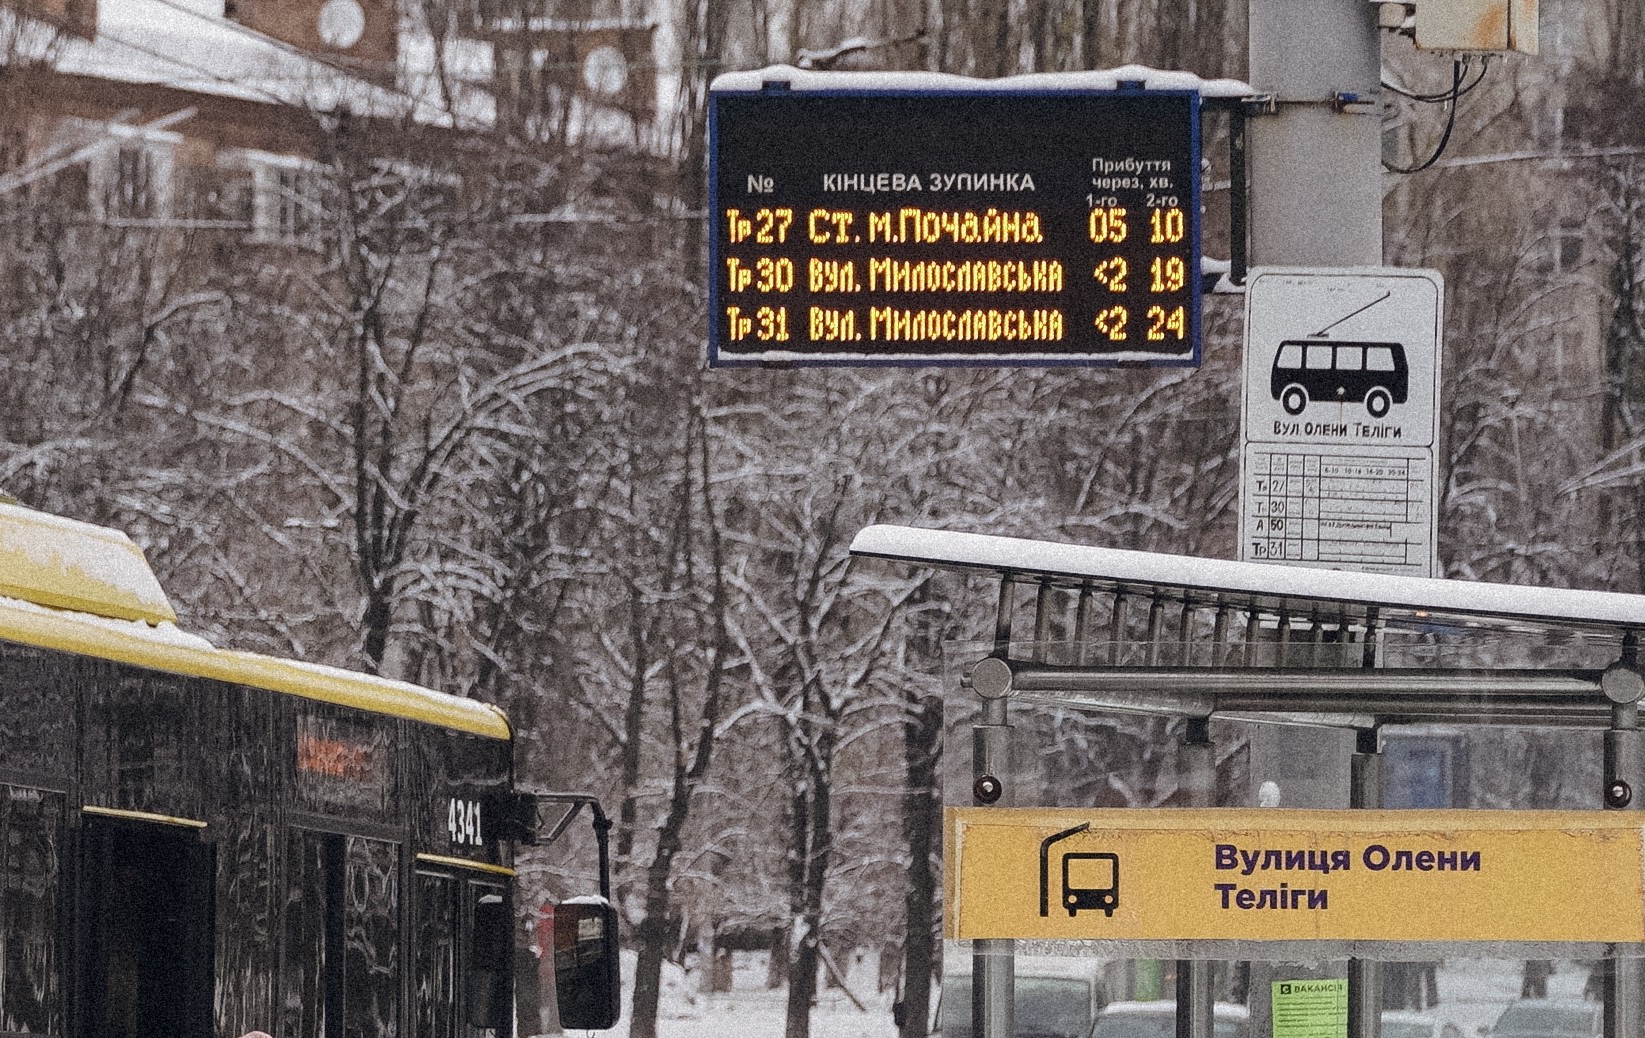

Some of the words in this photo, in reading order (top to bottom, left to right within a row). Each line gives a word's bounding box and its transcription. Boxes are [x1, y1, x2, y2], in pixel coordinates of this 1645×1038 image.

[1092, 157, 1171, 175] Прибуття
[747, 175, 774, 193] №
[823, 173, 923, 194] КІНЦЕВА
[930, 173, 1036, 192] ЗУПИНКА
[1086, 193, 1118, 207] 1-го
[1146, 193, 1179, 207] 2-го
[1090, 208, 1127, 243] 05
[1151, 208, 1184, 243] 10
[1151, 256, 1185, 292] 19
[1148, 305, 1185, 340] 24
[1271, 501, 1285, 513] 30
[448, 798, 483, 846] 4341
[1214, 844, 1351, 876] Вулиця
[1362, 844, 1482, 872] Олени
[1214, 883, 1329, 910] Теліги
